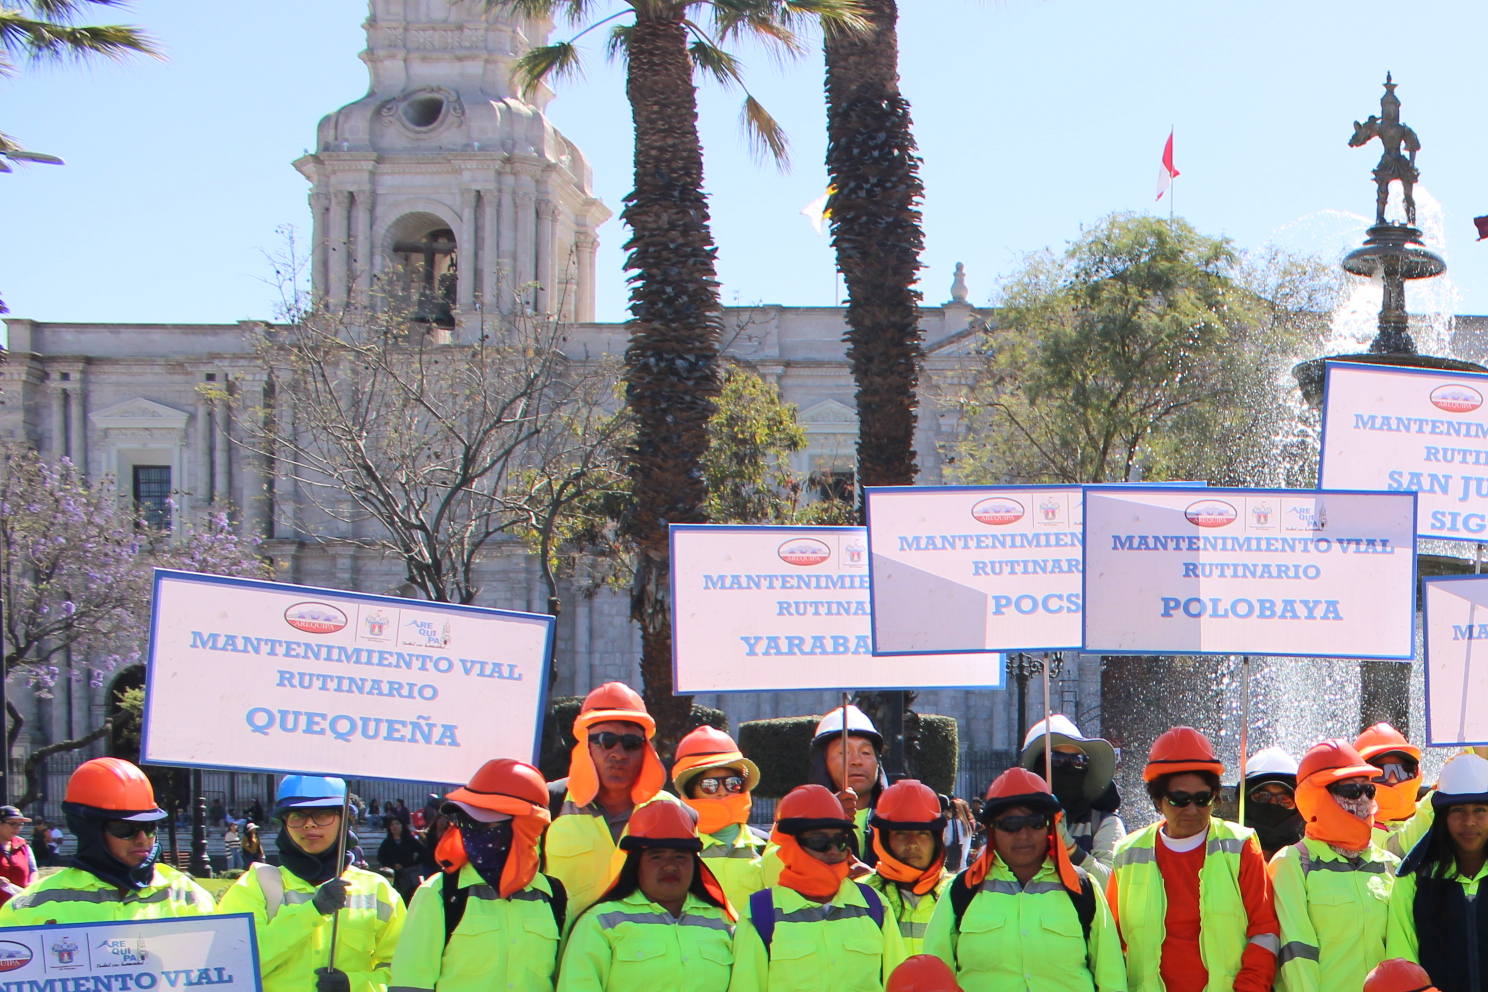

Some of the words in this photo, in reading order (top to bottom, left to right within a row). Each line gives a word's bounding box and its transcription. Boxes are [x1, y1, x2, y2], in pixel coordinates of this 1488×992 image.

[1437, 401, 1472, 409] AREQUIPA
[1386, 469, 1450, 494] SAN
[897, 532, 1083, 551] MANTENIMIEN
[1111, 534, 1332, 553] MANTENIMIENTO
[1335, 537, 1395, 554] VIAL
[971, 558, 1083, 576] RUTINAR
[1182, 562, 1321, 579] RUTINARIO
[702, 574, 870, 590] MANTENIMIE
[775, 600, 871, 616] RUTINA
[991, 592, 1082, 616] POCS
[1160, 596, 1342, 619] POLOBAYA
[293, 620, 335, 630] AREQUIPA
[740, 634, 872, 656] YARABA
[189, 630, 454, 673] MANTENIMIENTO
[458, 658, 523, 681] VIAL
[275, 669, 439, 701] RUTINARIO
[245, 706, 459, 746] QUEQUEÑA
[160, 966, 233, 987] VIAL
